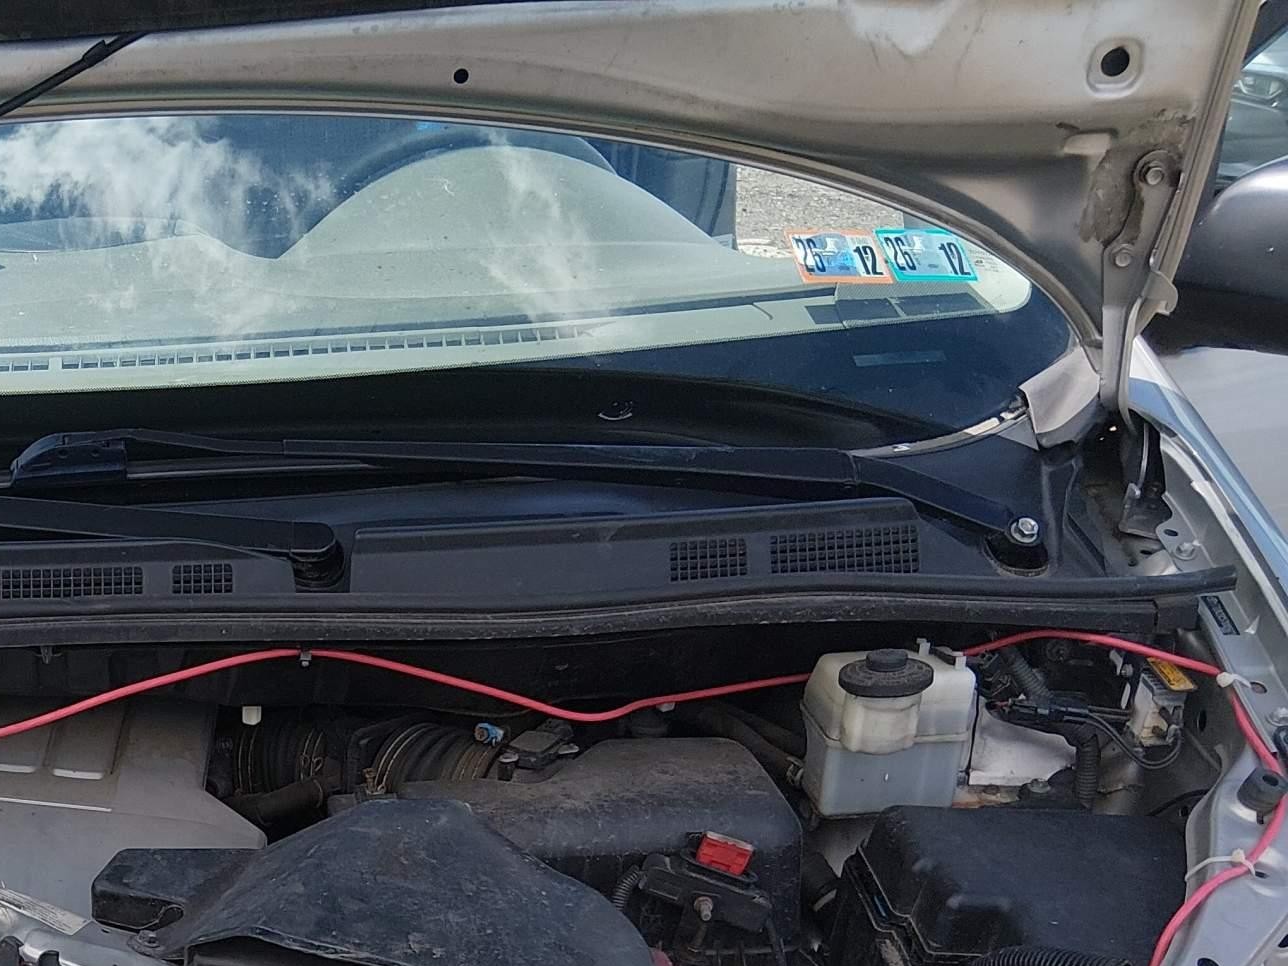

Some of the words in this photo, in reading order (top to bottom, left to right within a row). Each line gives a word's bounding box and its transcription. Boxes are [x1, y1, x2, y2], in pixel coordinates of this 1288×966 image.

[795, 237, 826, 273] 26
[854, 245, 883, 275] 12
[885, 236, 917, 271] 26
[939, 242, 972, 275] 12
